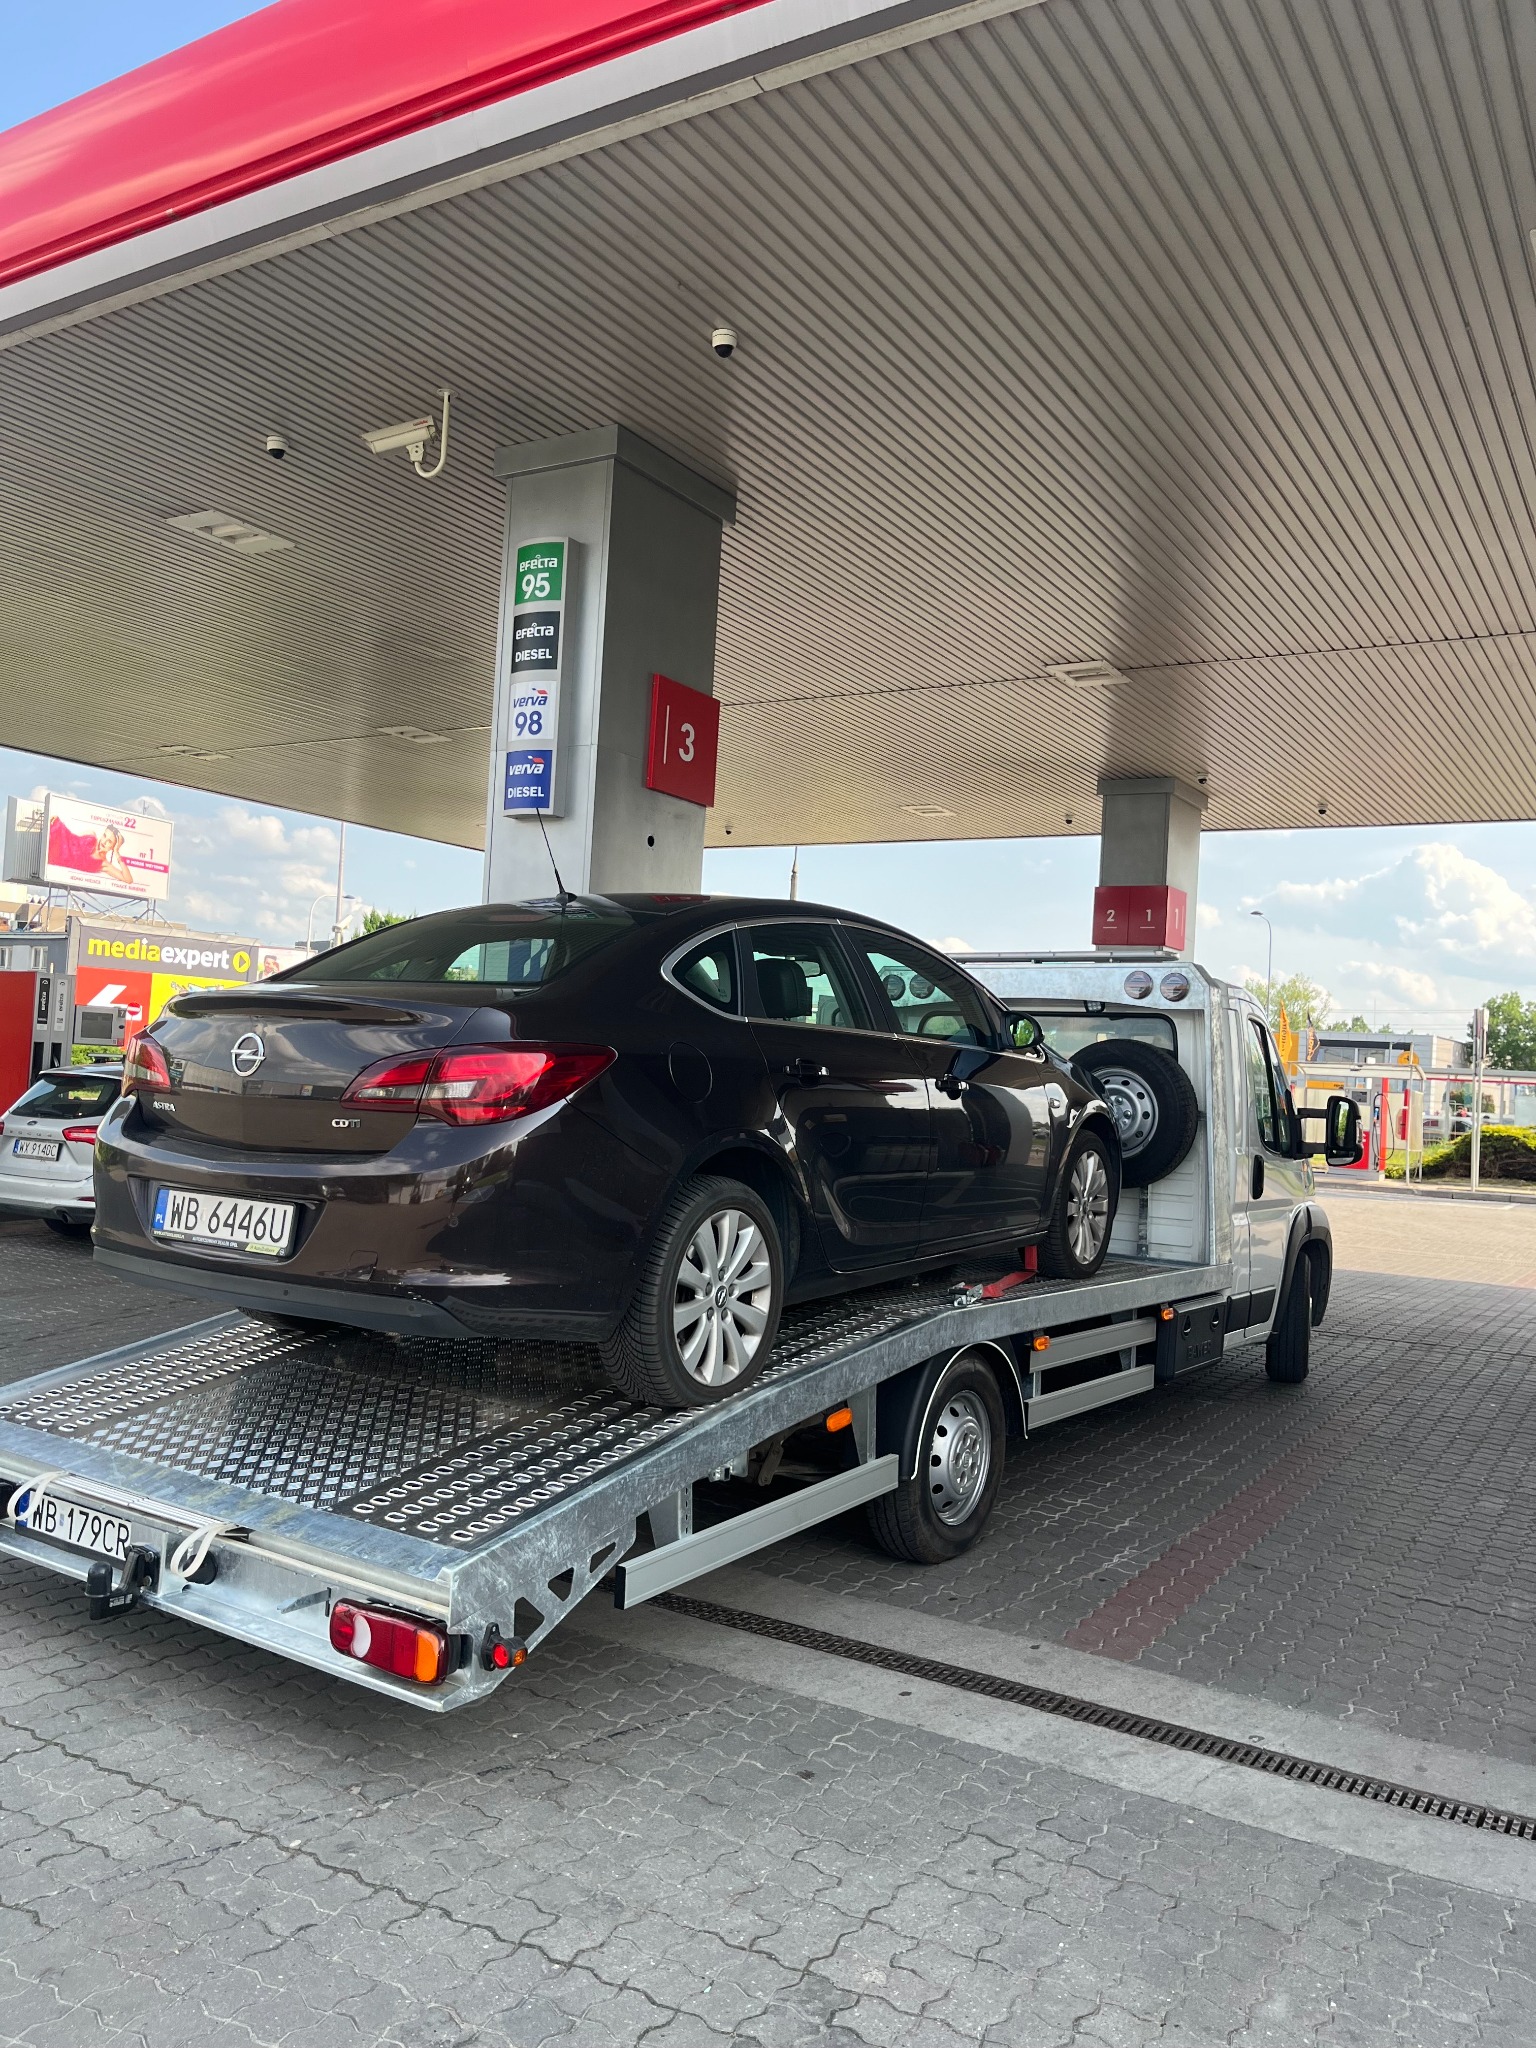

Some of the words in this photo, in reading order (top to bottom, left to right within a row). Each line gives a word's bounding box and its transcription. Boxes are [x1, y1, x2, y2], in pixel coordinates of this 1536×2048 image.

[521, 573, 551, 599] 95
[515, 649, 552, 662] DIESEL
[513, 692, 548, 708] verva
[515, 711, 543, 736] 98
[678, 723, 695, 762] 3
[509, 761, 544, 776] verva
[507, 786, 544, 798] DIESEL
[124, 817, 137, 829] 22
[1106, 909, 1116, 922] 2
[1145, 909, 1152, 922] 1
[152, 1100, 176, 1112] ASTRA
[20, 1141, 31, 1153] WX
[155, 1213, 164, 1224] PL
[170, 1195, 199, 1231] WB
[207, 1200, 288, 1243] 6446U
[33, 1498, 57, 1533] WB
[68, 1507, 130, 1560] 179CR
